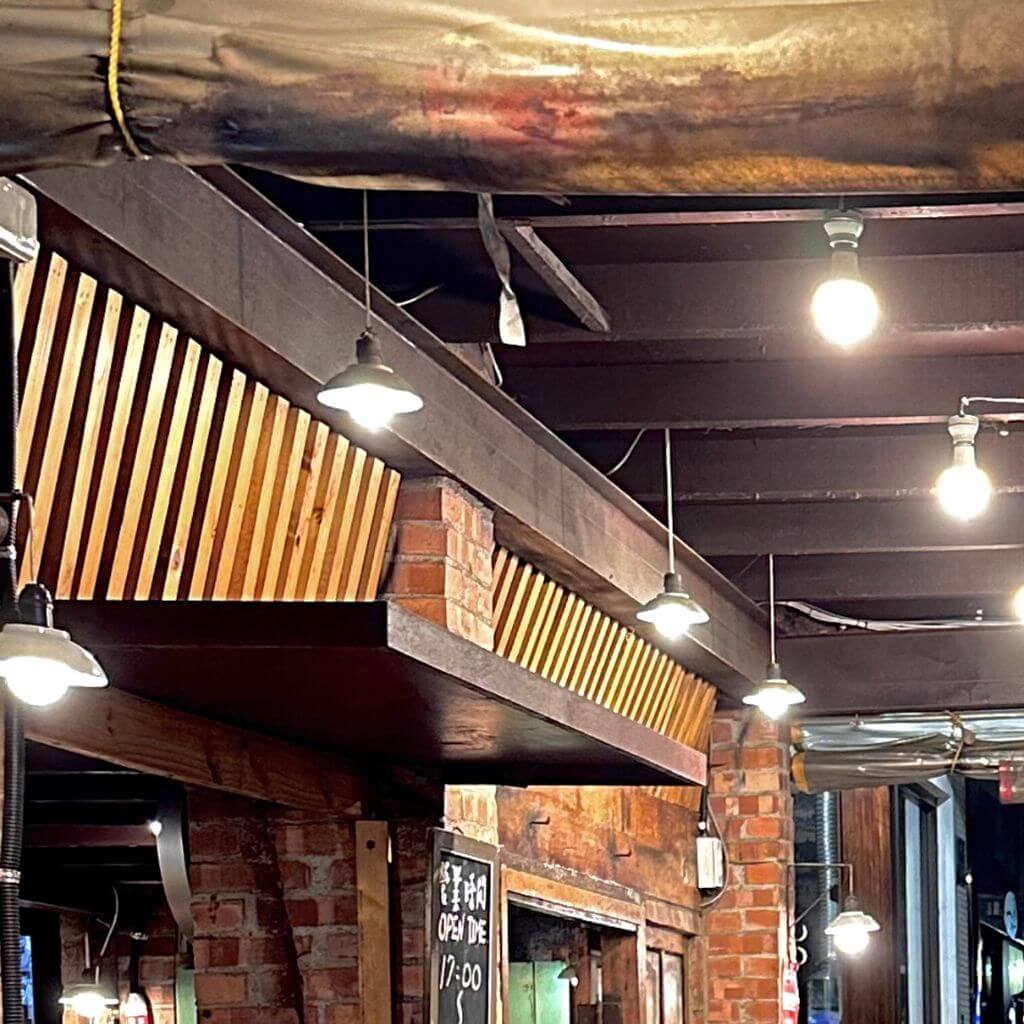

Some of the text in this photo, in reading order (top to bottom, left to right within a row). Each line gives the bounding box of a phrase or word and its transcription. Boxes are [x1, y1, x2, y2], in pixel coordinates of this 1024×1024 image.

[440, 861, 487, 912] 營業時間
[438, 912, 466, 942] OPEN
[439, 954, 482, 991] 17:00
